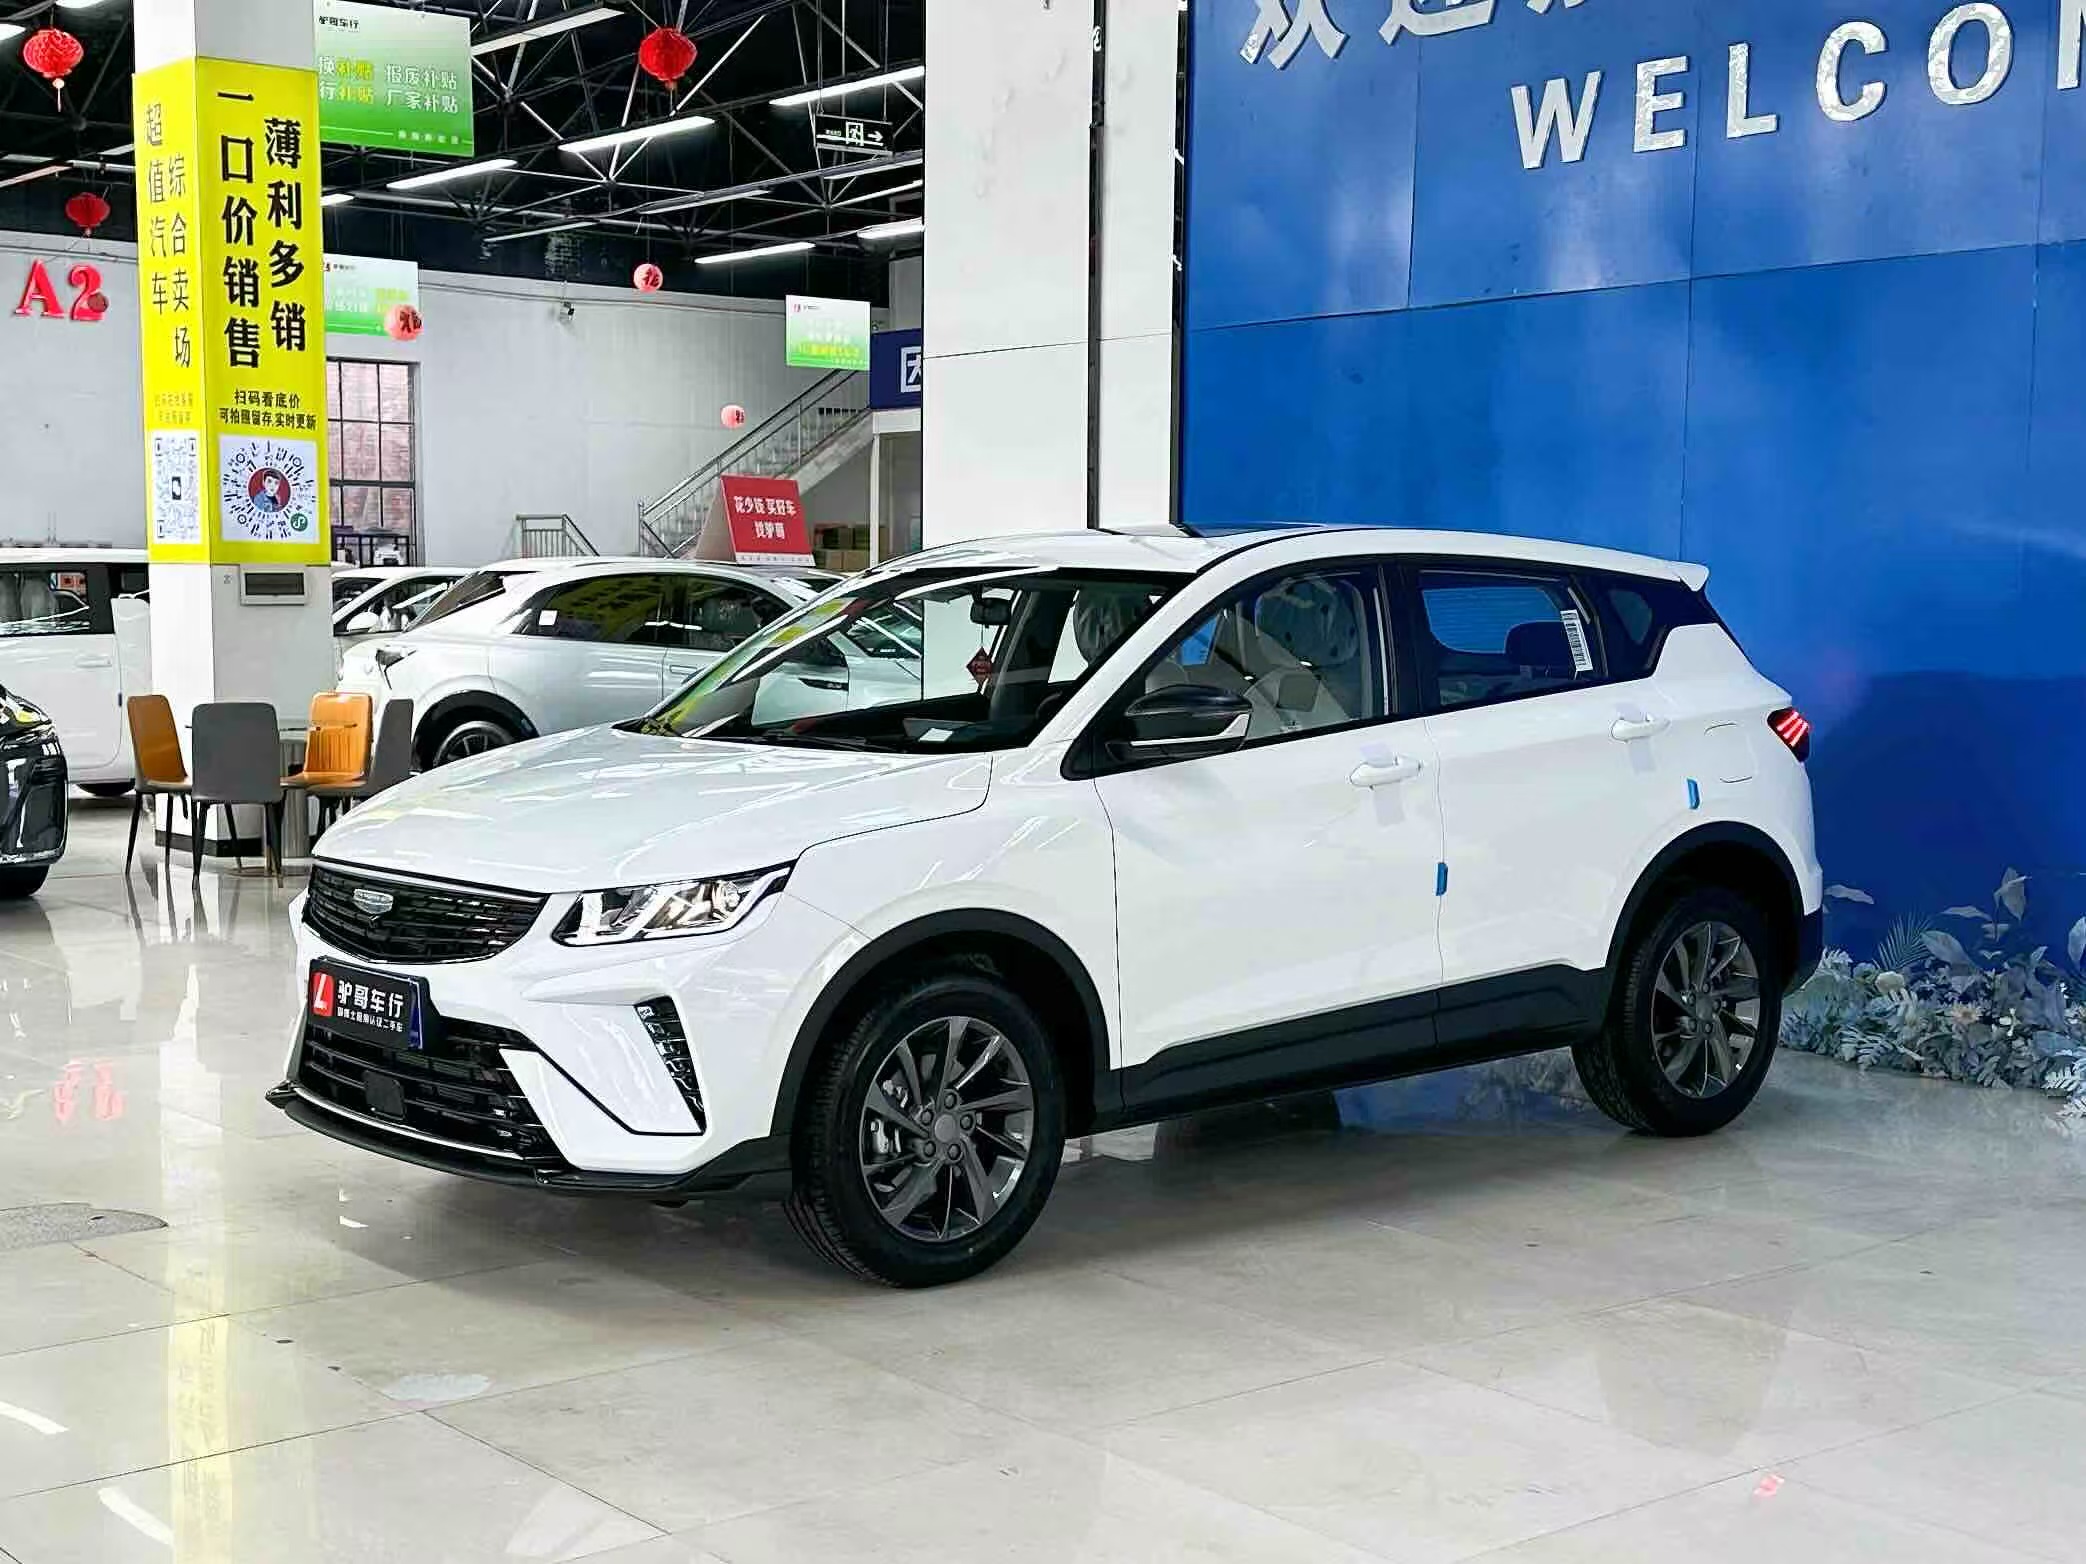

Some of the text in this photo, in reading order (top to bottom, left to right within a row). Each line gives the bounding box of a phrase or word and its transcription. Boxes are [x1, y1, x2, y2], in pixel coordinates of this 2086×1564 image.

[11, 258, 106, 322] A2
[146, 104, 168, 315] 超值汽车
[169, 153, 191, 368] 综合卖场
[217, 91, 260, 368] 一口价销售
[264, 117, 306, 351] 薄利多销
[234, 389, 300, 408] 扫码看底价
[337, 980, 404, 1018] 驴哥车行
